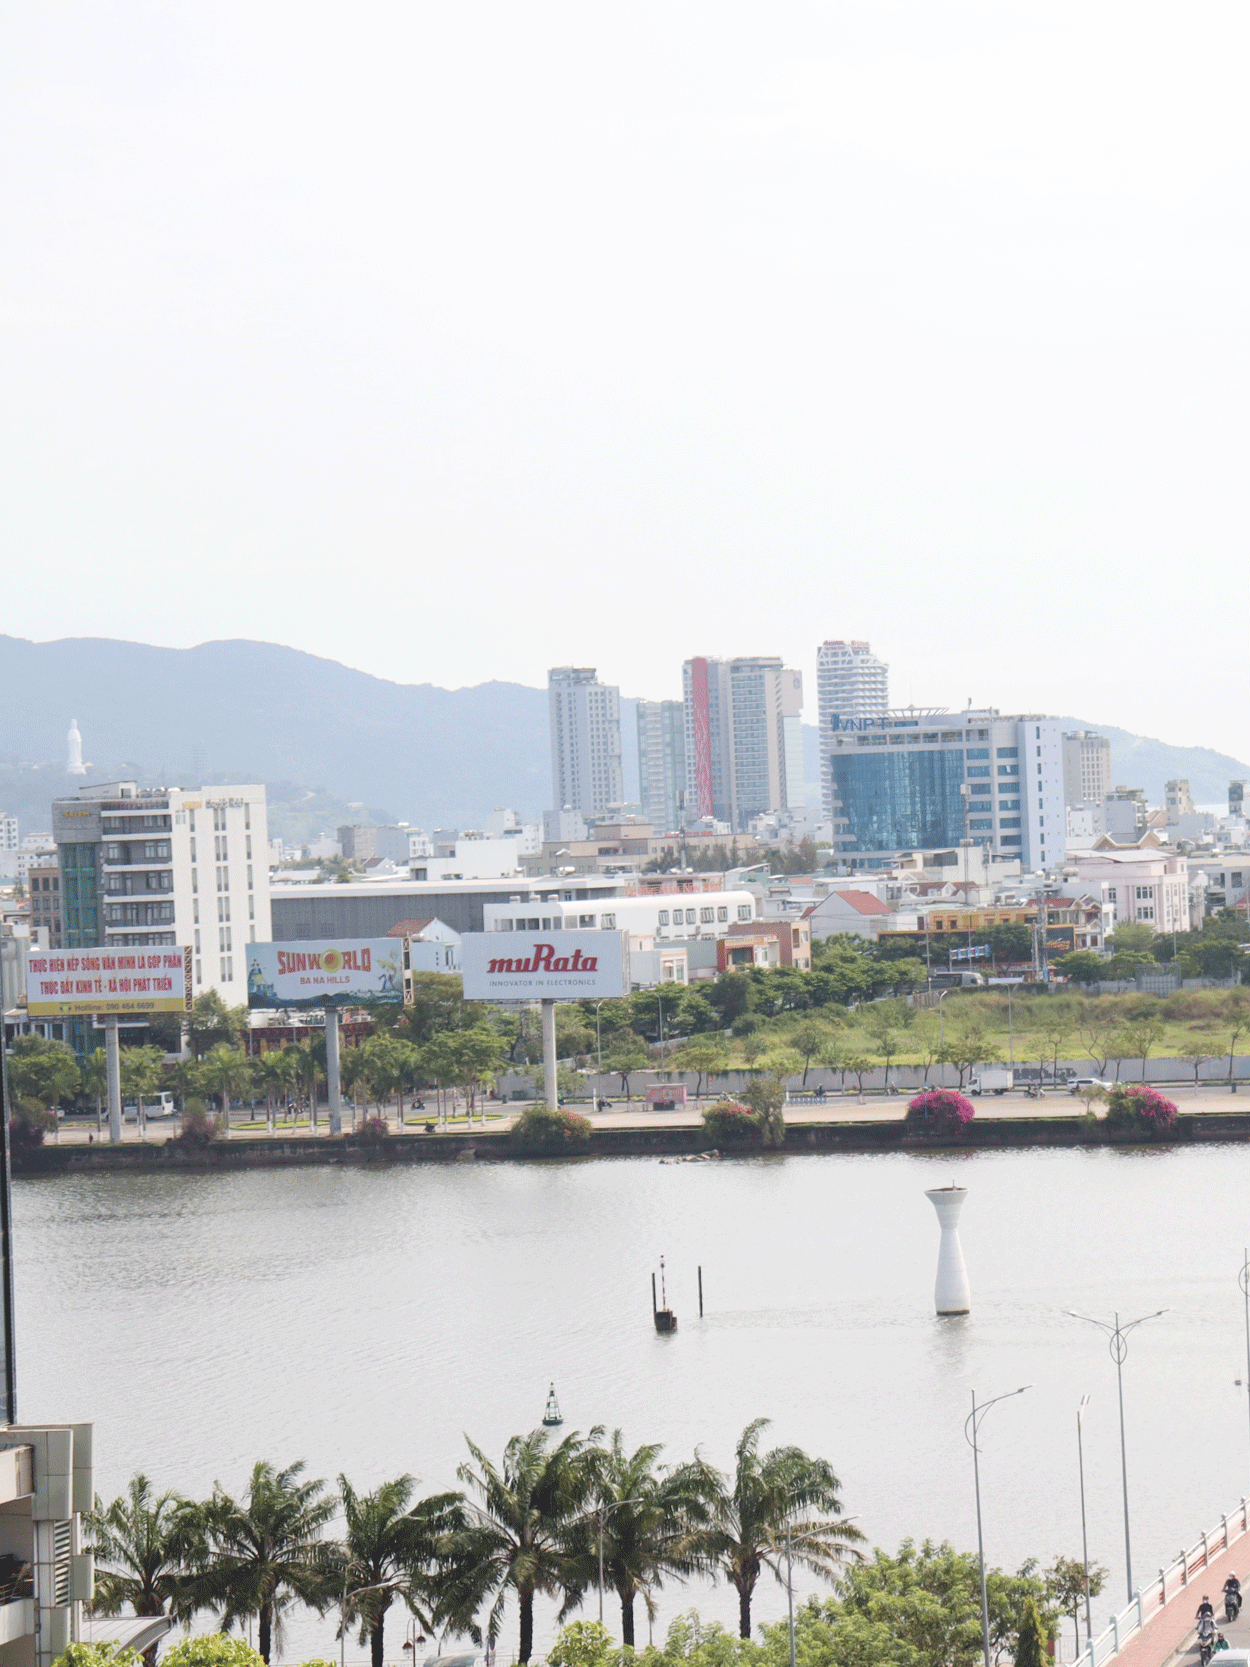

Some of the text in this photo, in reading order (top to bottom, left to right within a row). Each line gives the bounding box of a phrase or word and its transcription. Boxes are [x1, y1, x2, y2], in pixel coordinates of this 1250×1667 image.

[840, 717, 889, 731] VNPT
[486, 944, 598, 973] muRata
[327, 976, 350, 984] HILLS
[489, 979, 533, 987] INNOVATOR
